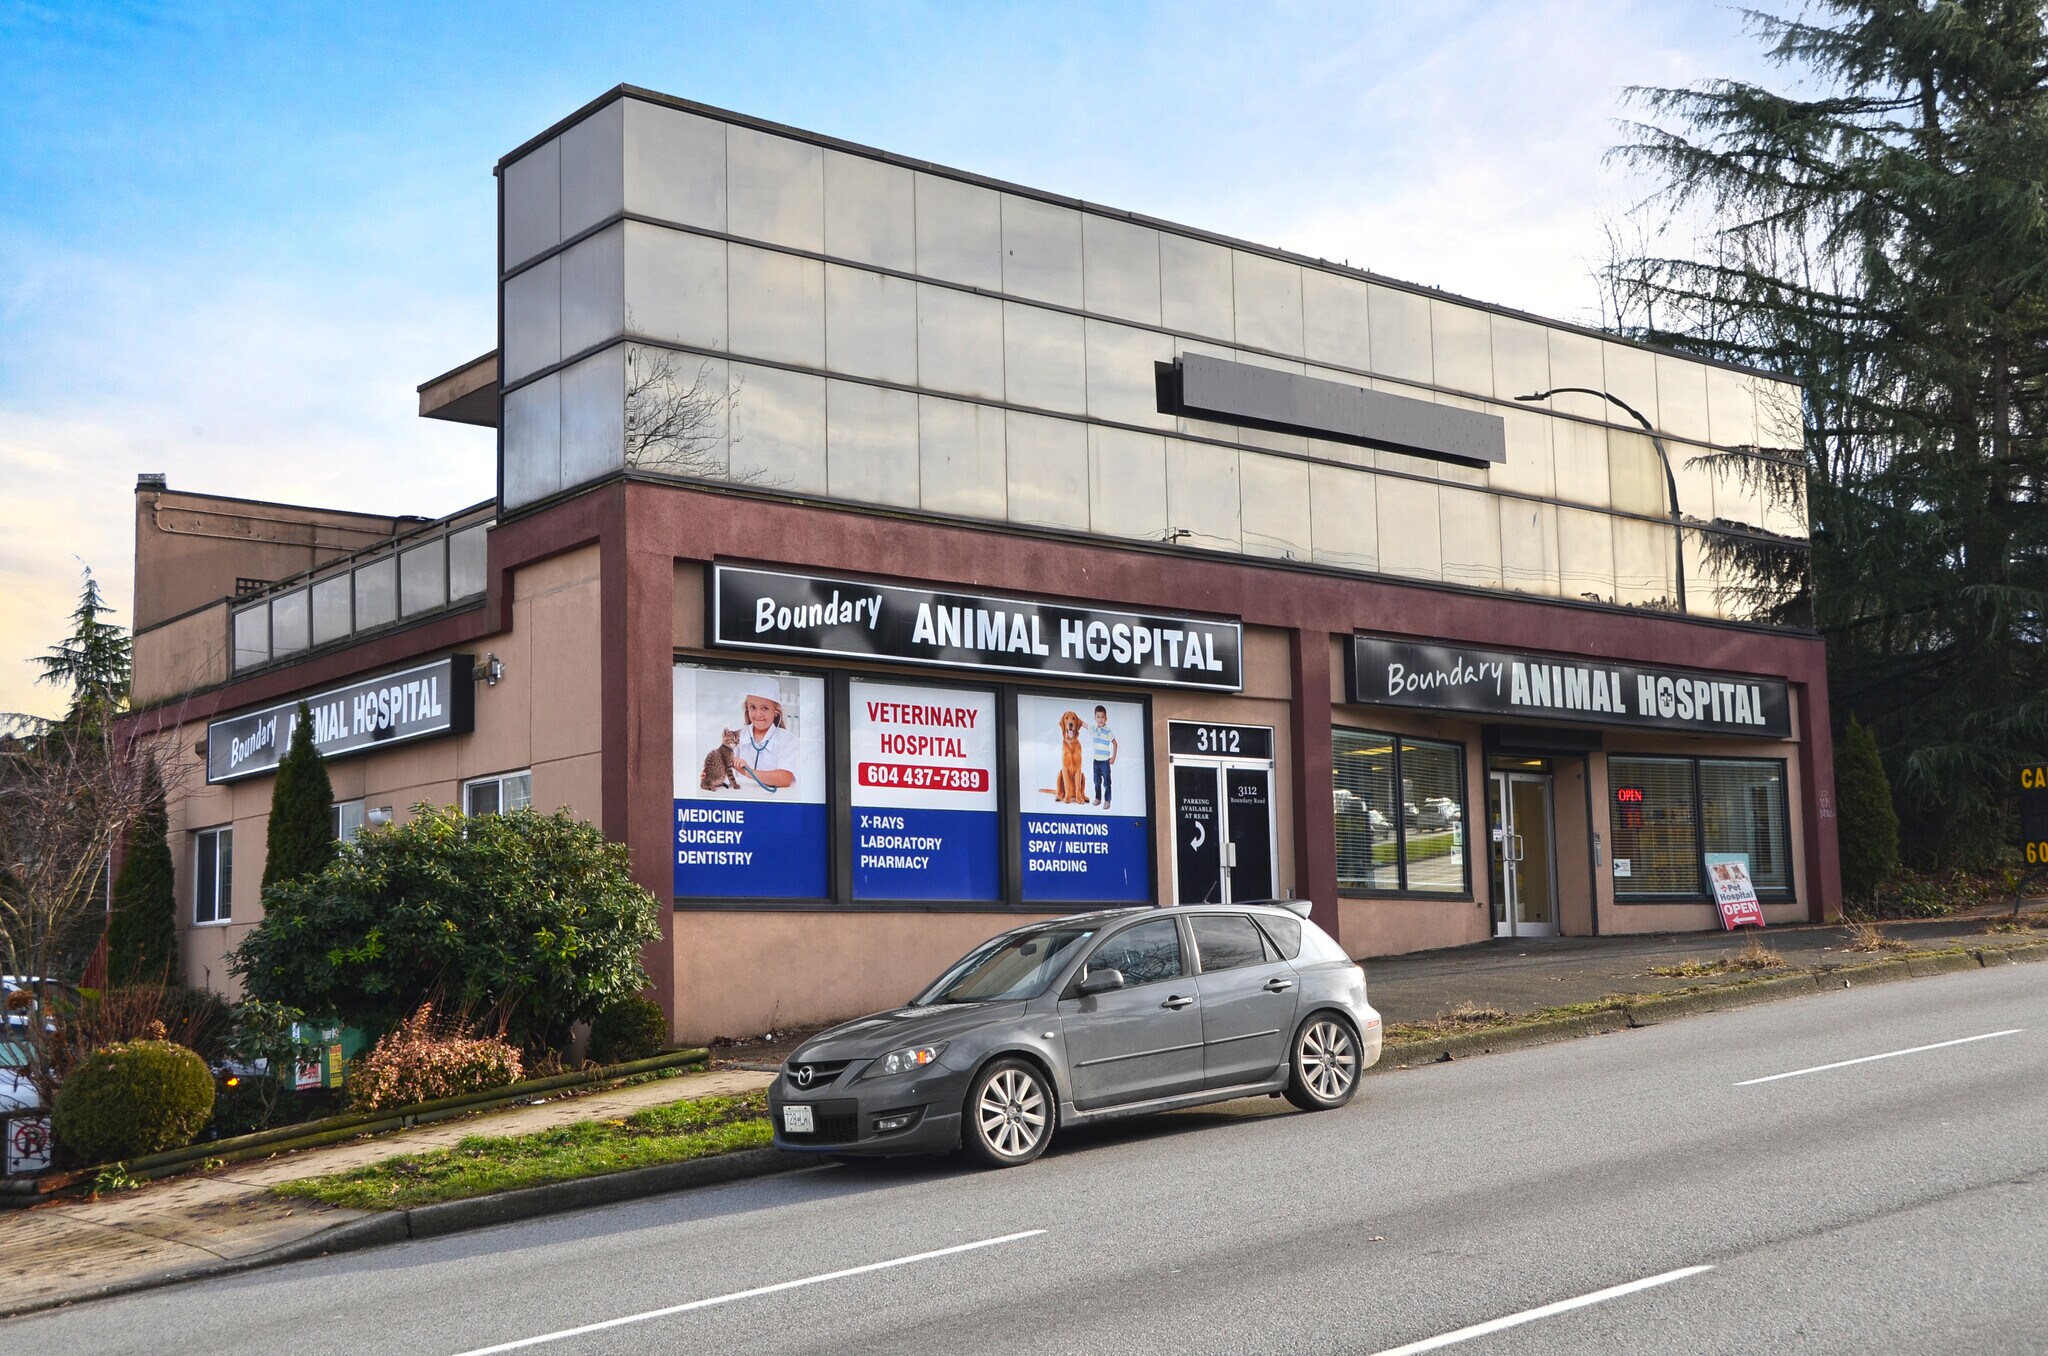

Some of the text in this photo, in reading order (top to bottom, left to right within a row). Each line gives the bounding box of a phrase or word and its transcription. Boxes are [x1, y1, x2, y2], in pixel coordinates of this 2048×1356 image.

[754, 590, 1223, 672] Boundary ANIMAL HOSPITAL
[1387, 656, 1766, 726] Boundary ANIMAL HOSPITAL
[230, 676, 442, 769] Boundary AMAL HOSPITAL
[867, 701, 978, 729] VETERINARY
[881, 733, 967, 758] HOSPITAL
[1197, 728, 1240, 753] 3112
[867, 765, 980, 789] 604 437-7389
[2021, 767, 2048, 789] CA
[1238, 785, 1257, 797] 3112
[1618, 789, 1642, 802] OPEN
[1230, 797, 1253, 805] Boundary
[678, 808, 745, 824] MEDICINE
[1180, 805, 1213, 813] AVAILABLE
[861, 815, 905, 830] X-RAYS
[1028, 821, 1109, 836] VACCINATIONS
[678, 829, 743, 844] SURGERY
[861, 835, 942, 850] LABORATORY
[1028, 840, 1056, 853] SPAY
[1065, 841, 1109, 854] NEUTER
[678, 850, 753, 866] DENTISTRY
[861, 855, 929, 870] PHARMACY
[1029, 859, 1088, 873] BOARDING
[1727, 884, 1741, 892] Pet
[1720, 891, 1754, 901] Hospital
[1723, 901, 1758, 916] OPEN
